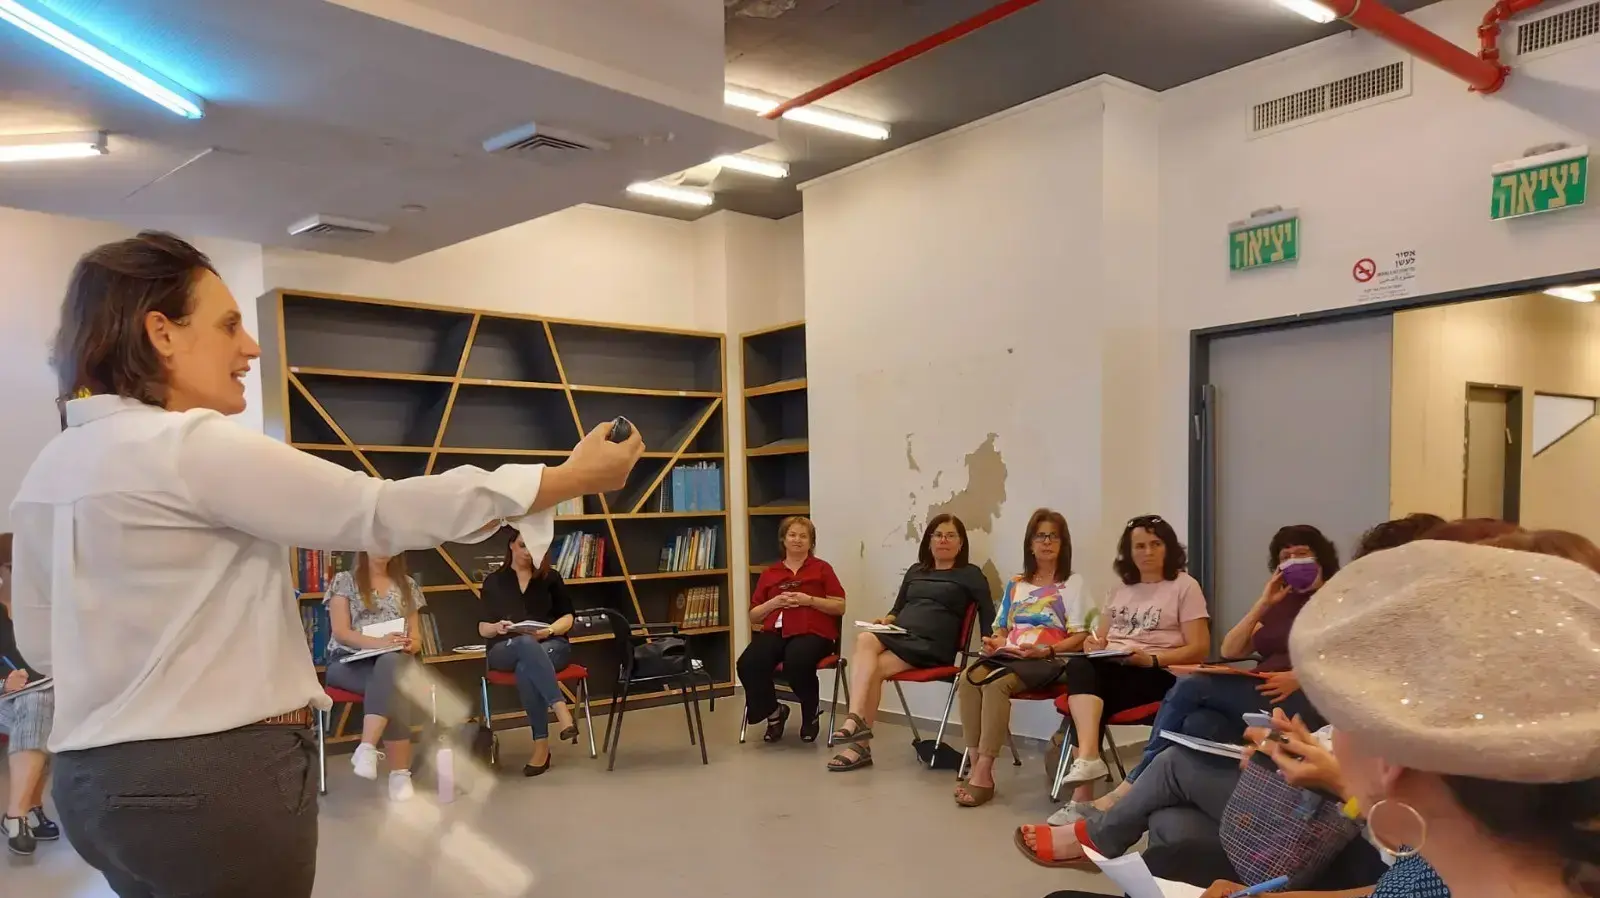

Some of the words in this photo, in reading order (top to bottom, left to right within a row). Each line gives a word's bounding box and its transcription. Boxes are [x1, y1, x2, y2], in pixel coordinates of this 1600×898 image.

[1498, 163, 1580, 216] יציאה
[1235, 223, 1291, 268] יציאה
[1395, 250, 1416, 259] אסור
[1395, 257, 1416, 268] לעשן
